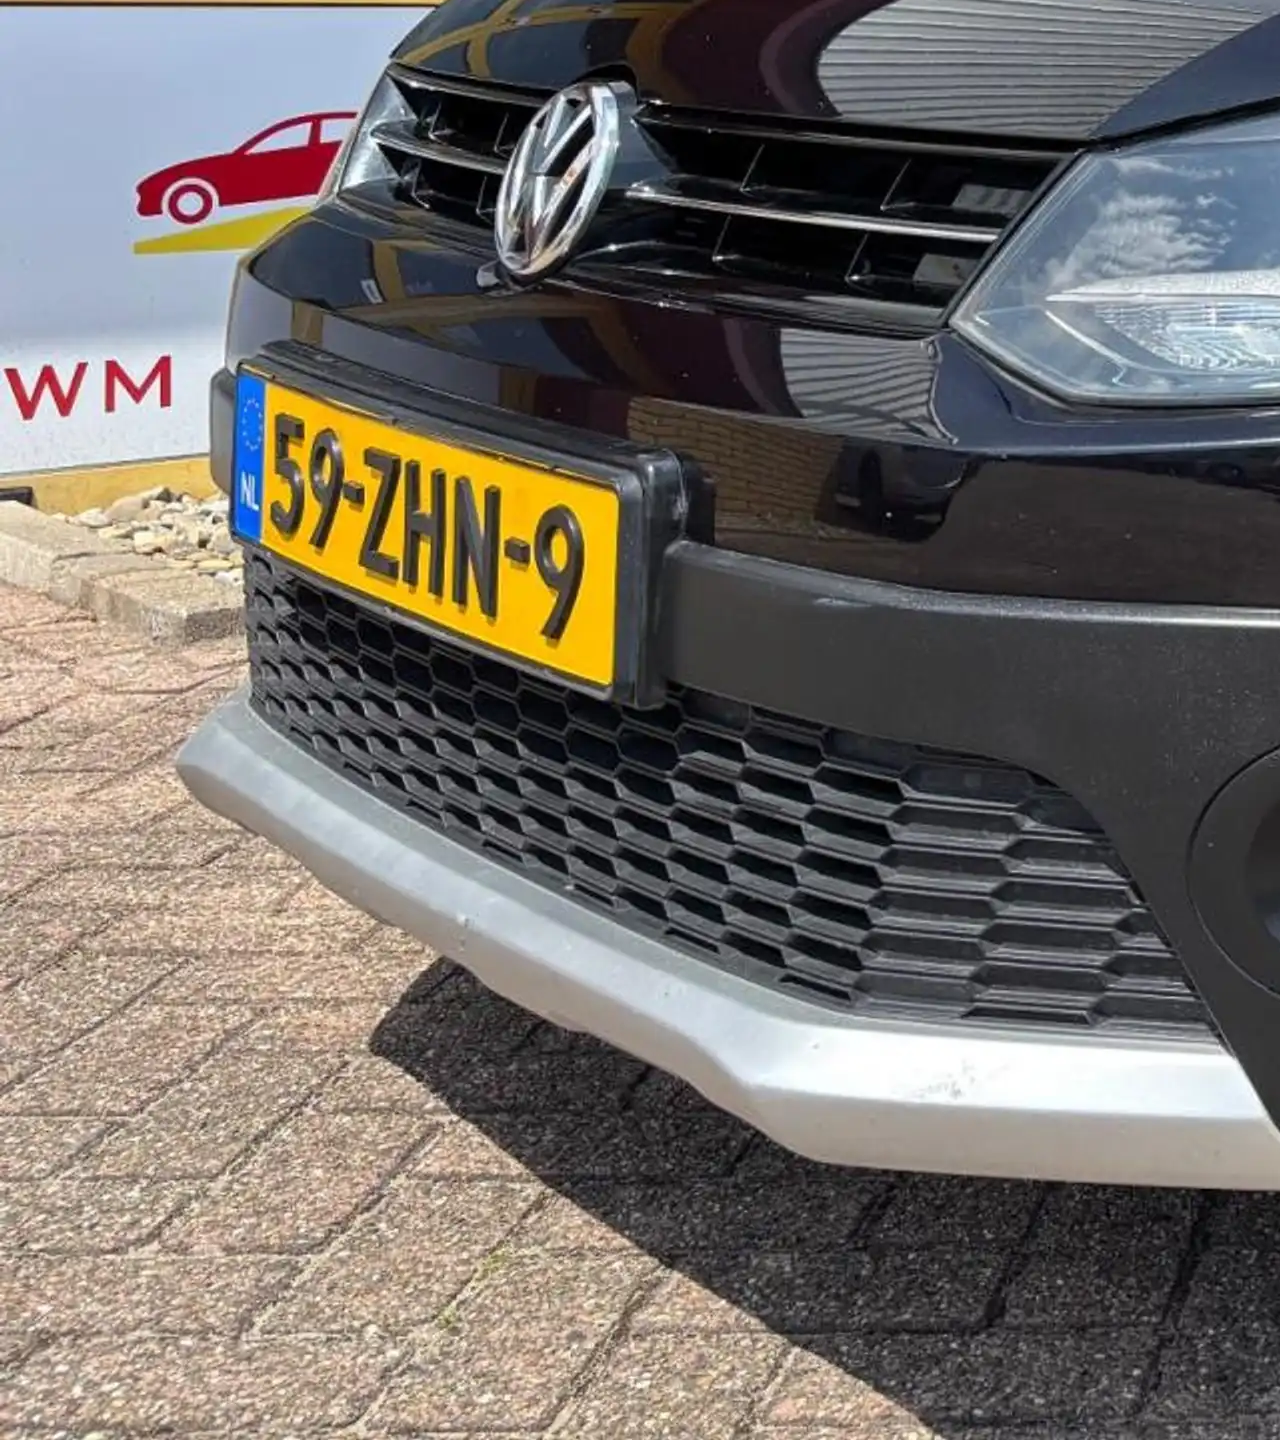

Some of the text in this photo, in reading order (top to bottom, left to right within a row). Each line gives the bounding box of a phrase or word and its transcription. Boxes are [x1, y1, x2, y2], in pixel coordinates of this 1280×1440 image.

[4, 355, 172, 421] WM
[241, 471, 259, 511] NL
[270, 413, 585, 640] 59-ZHN-9
